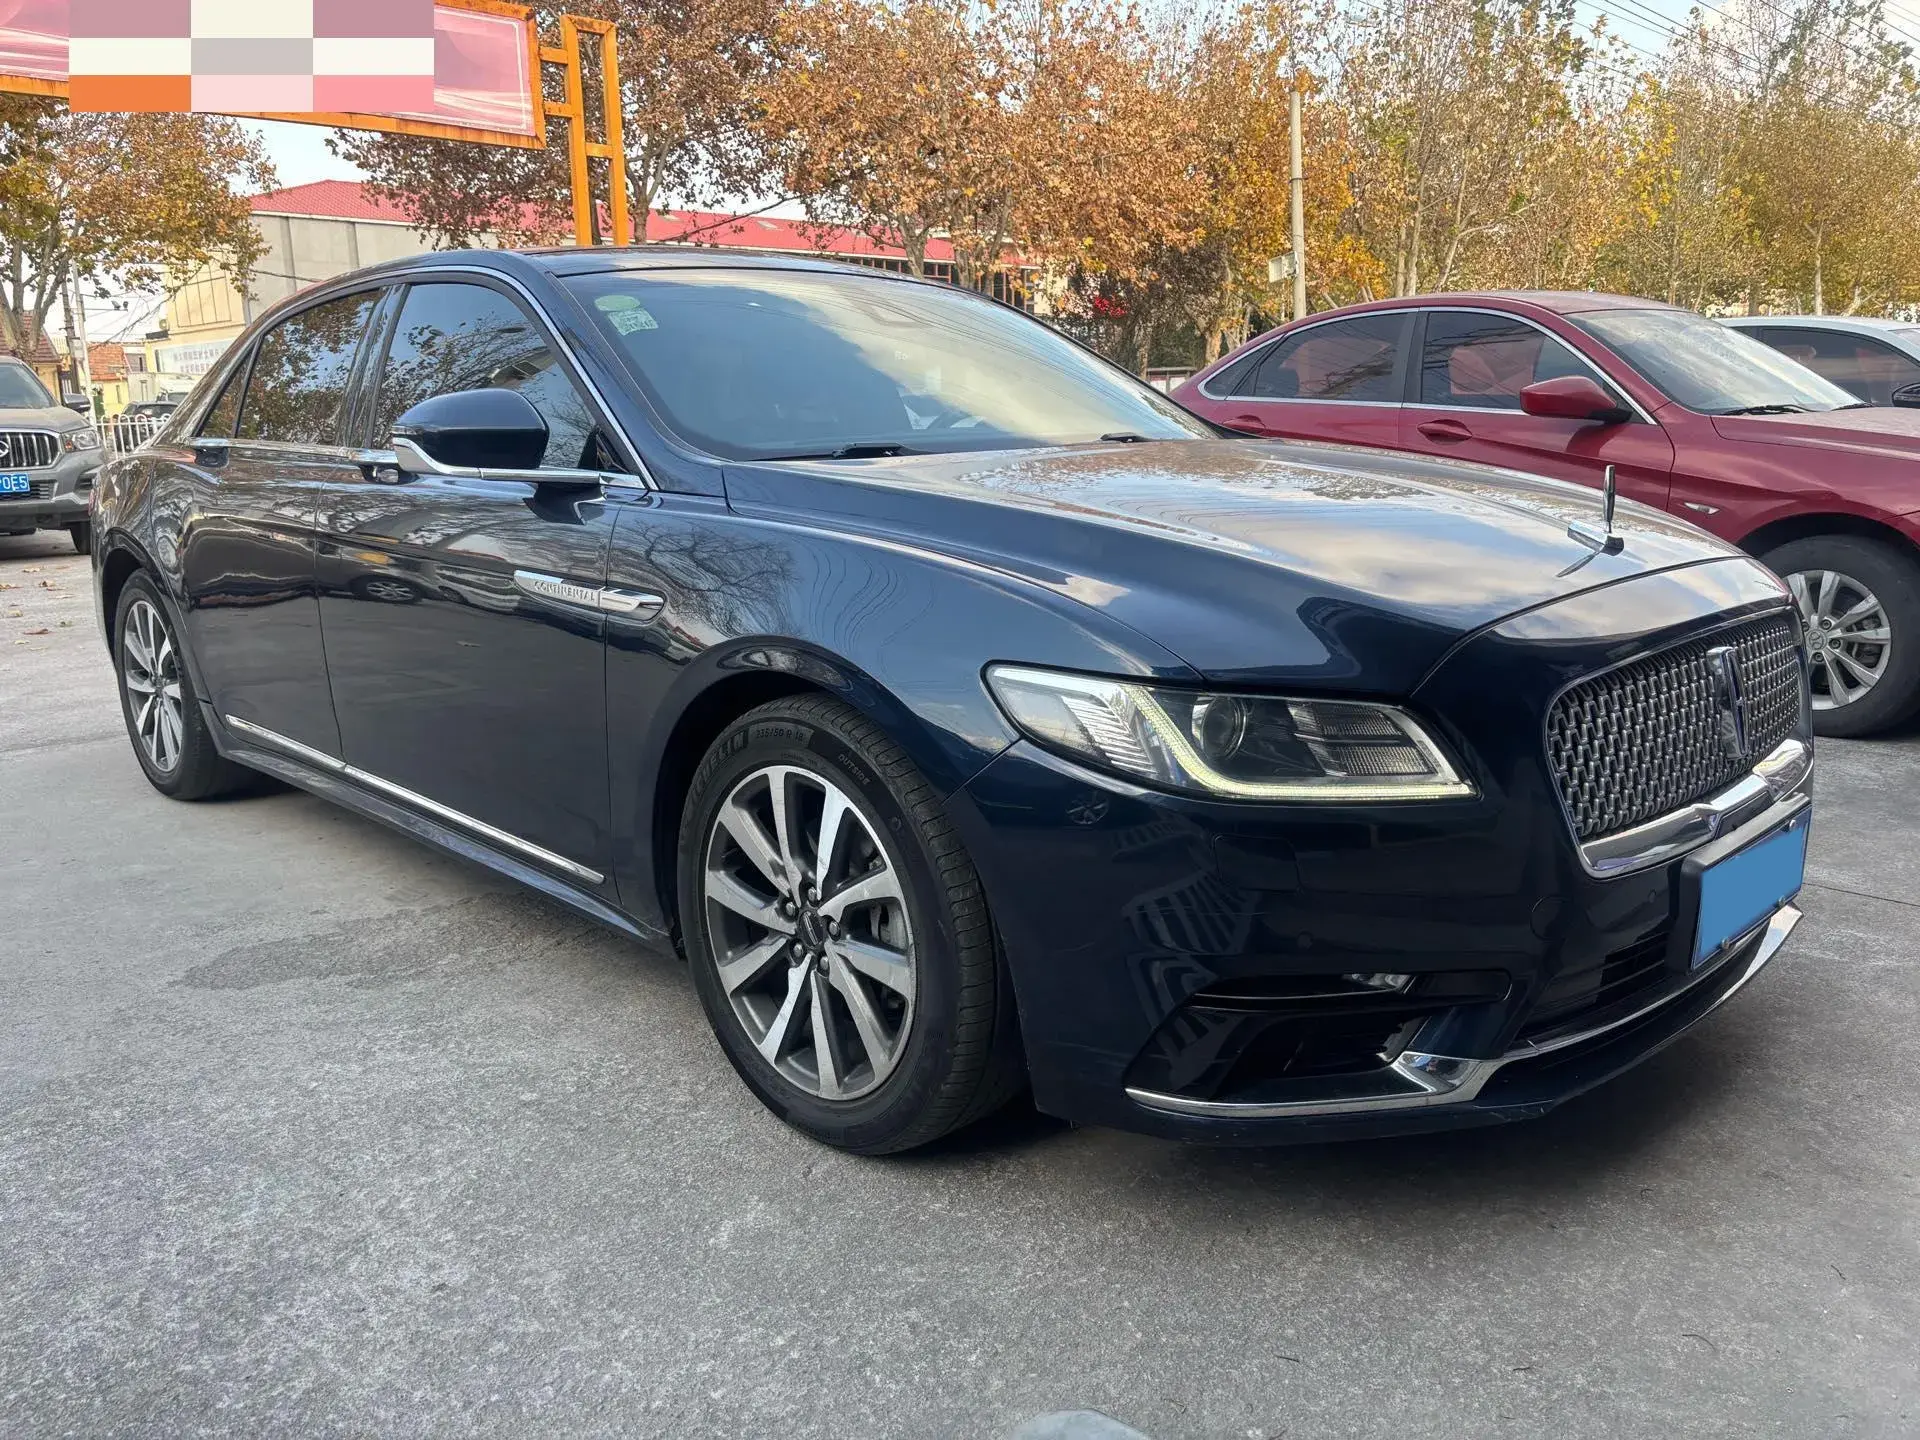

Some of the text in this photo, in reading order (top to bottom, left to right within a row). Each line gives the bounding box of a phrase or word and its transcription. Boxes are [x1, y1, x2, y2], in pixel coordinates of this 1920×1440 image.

[0, 476, 27, 490] 0E5
[534, 580, 595, 602] CONTINENTAL
[838, 753, 871, 785] OUTSIDE
